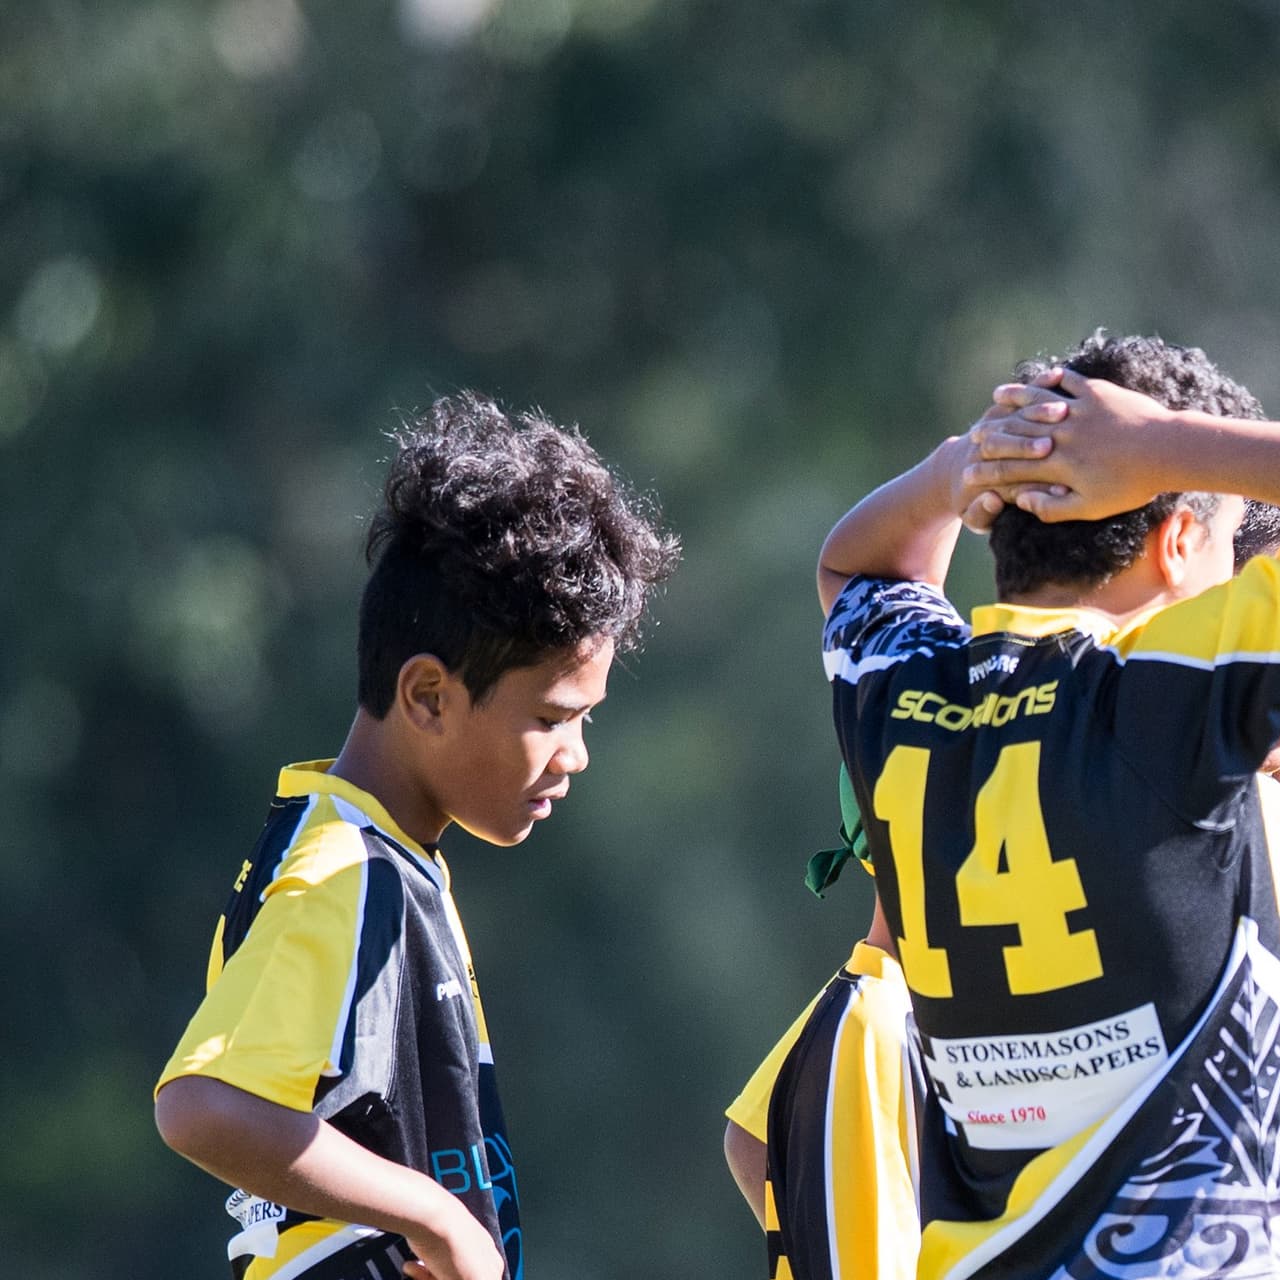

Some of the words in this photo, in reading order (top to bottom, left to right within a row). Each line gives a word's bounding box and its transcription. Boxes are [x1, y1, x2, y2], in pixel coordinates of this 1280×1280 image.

[873, 740, 1103, 998] 14
[946, 1020, 1131, 1064] STONEMASONS
[956, 1071, 973, 1089] &
[975, 1036, 1162, 1087] LANDSCAPERS
[966, 1109, 1005, 1124] Since
[1011, 1105, 1047, 1123] 1970
